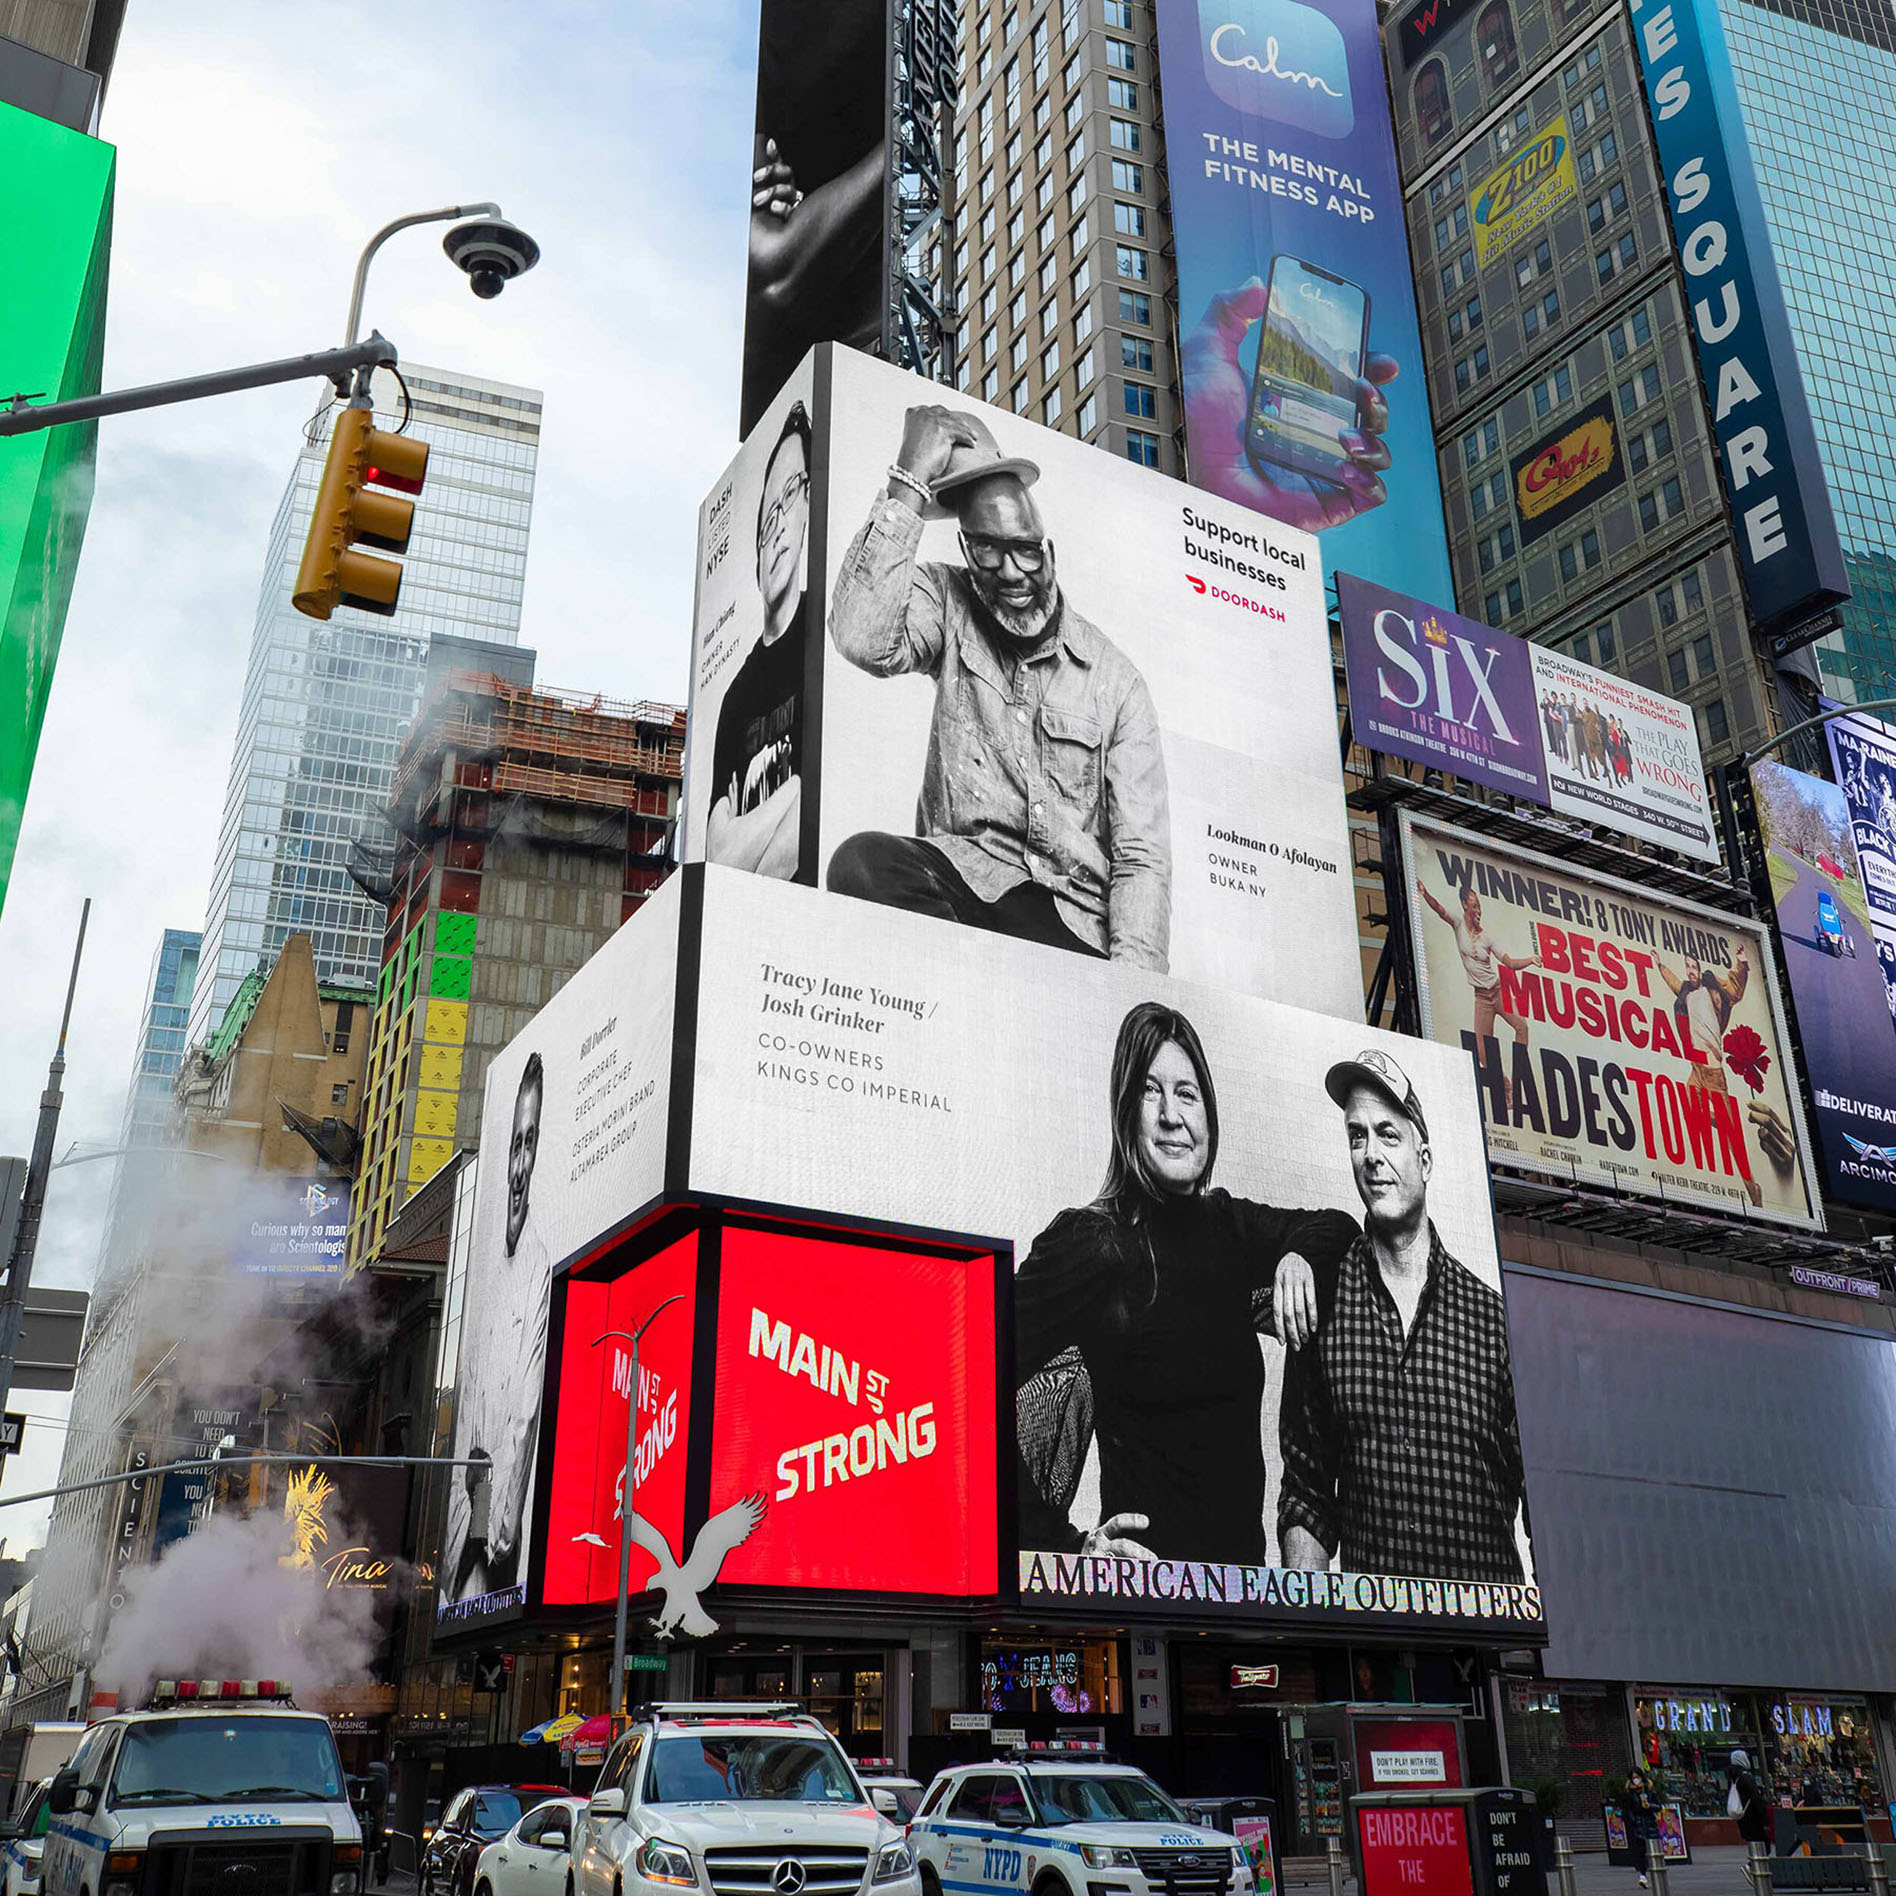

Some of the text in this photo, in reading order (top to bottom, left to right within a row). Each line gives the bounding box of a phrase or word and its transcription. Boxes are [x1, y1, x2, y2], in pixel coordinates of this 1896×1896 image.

[1210, 23, 1344, 98] Calm
[1203, 132, 1371, 200] THE MENTAL
[1487, 135, 1557, 227] Z100
[1205, 159, 1375, 224] FITNESS APP
[1482, 184, 1574, 263] Hit Music Station
[1488, 217, 1513, 246] New
[1631, 0, 1788, 565] ES SQUARE
[708, 481, 734, 525] DASH
[706, 535, 730, 580] NYSE
[1182, 506, 1306, 571] Support local
[1184, 535, 1287, 591] businesses
[1211, 585, 1287, 623] DOORDASH
[1373, 609, 1520, 746] SIX
[1535, 666, 1688, 731] AND INTERNATIONAL PHENOMENON
[1538, 655, 1682, 719] BROADWAY'S FUNNIEST SMASH HIT
[1410, 710, 1497, 757] THE MUSICAL
[1657, 731, 1688, 757] PLAY
[1635, 757, 1703, 803] WRONG
[1661, 750, 1699, 777] GOES
[1567, 784, 1585, 796] NEW
[1585, 790, 1612, 806] WORLD
[1613, 799, 1639, 816] STAGES
[1207, 824, 1338, 874] Lookman O Afolayan
[1856, 827, 1893, 857] BLACK
[1208, 853, 1258, 877] OWNER
[1210, 873, 1267, 898] BUKA NY
[1435, 848, 1732, 970] WINNER! 8 TONY AWARDS
[1536, 922, 1656, 998] BEST
[760, 963, 939, 1021] Tracy Jane Young /
[761, 993, 885, 1035] Josh Grinker
[1498, 964, 1708, 1066] MUSICAL
[577, 1049, 618, 1095] CORPORATE
[758, 1033, 885, 1071] CO-OWNERS
[575, 1060, 633, 1122] EXECUTIVE CHEF
[757, 1061, 952, 1113] KINGS CO IMPERIAL
[1460, 1030, 1754, 1182] HADESTOWN
[572, 1125, 600, 1158] OSTERIA
[629, 1079, 656, 1112] BRAND
[610, 1120, 638, 1152] GROUP
[251, 1221, 289, 1236] Curious
[290, 1222, 311, 1239] why
[311, 1225, 323, 1236] so
[1795, 1268, 1879, 1297] OUTFRONT PRIME
[748, 1306, 890, 1406] MAIN ST
[193, 1409, 240, 1425] YOU DON'T
[203, 1427, 225, 1441] NEED
[613, 1388, 678, 1521] SRONG
[775, 1401, 937, 1502] STRONG
[184, 1485, 203, 1500] YOU
[320, 1547, 395, 1590] Tina
[1027, 1553, 1542, 1622] AMERICAN EAGLE OUTFITTERS
[634, 1656, 667, 1671] Broadway
[1654, 1700, 1834, 1736] GRAND SLAM
[207, 1818, 282, 1828] POLICE
[1366, 1812, 1458, 1848] EMBRACE
[1489, 1812, 1517, 1826] DON'T
[1492, 1834, 1505, 1847] BE
[1159, 1837, 1205, 1846] POLICE
[1495, 1852, 1531, 1866] AFRAID
[982, 1847, 1022, 1883] NYPD
[1398, 1859, 1426, 1884] THE
[1498, 1875, 1511, 1888] OF
